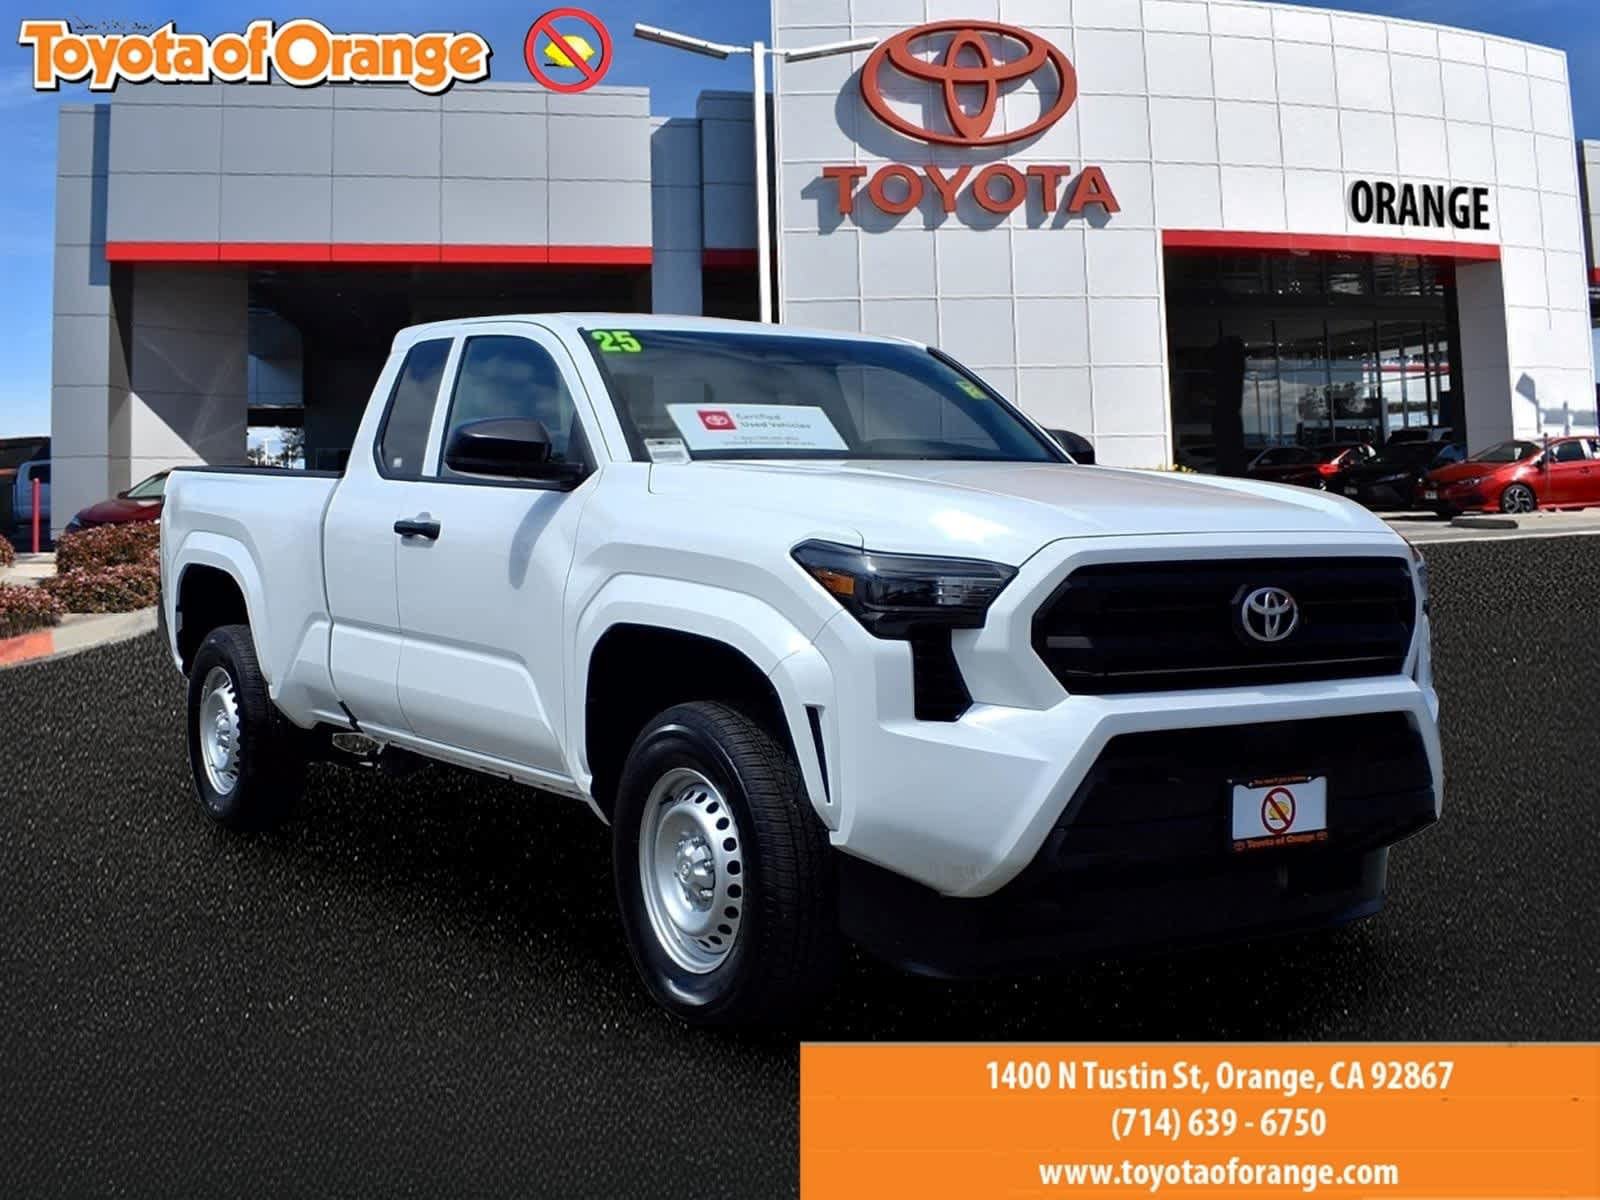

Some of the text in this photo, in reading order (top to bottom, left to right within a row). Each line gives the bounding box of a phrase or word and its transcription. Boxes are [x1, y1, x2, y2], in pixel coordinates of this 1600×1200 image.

[823, 164, 1120, 215] TOYOTA
[1350, 179, 1490, 230] ORANGE
[591, 330, 642, 353] 25
